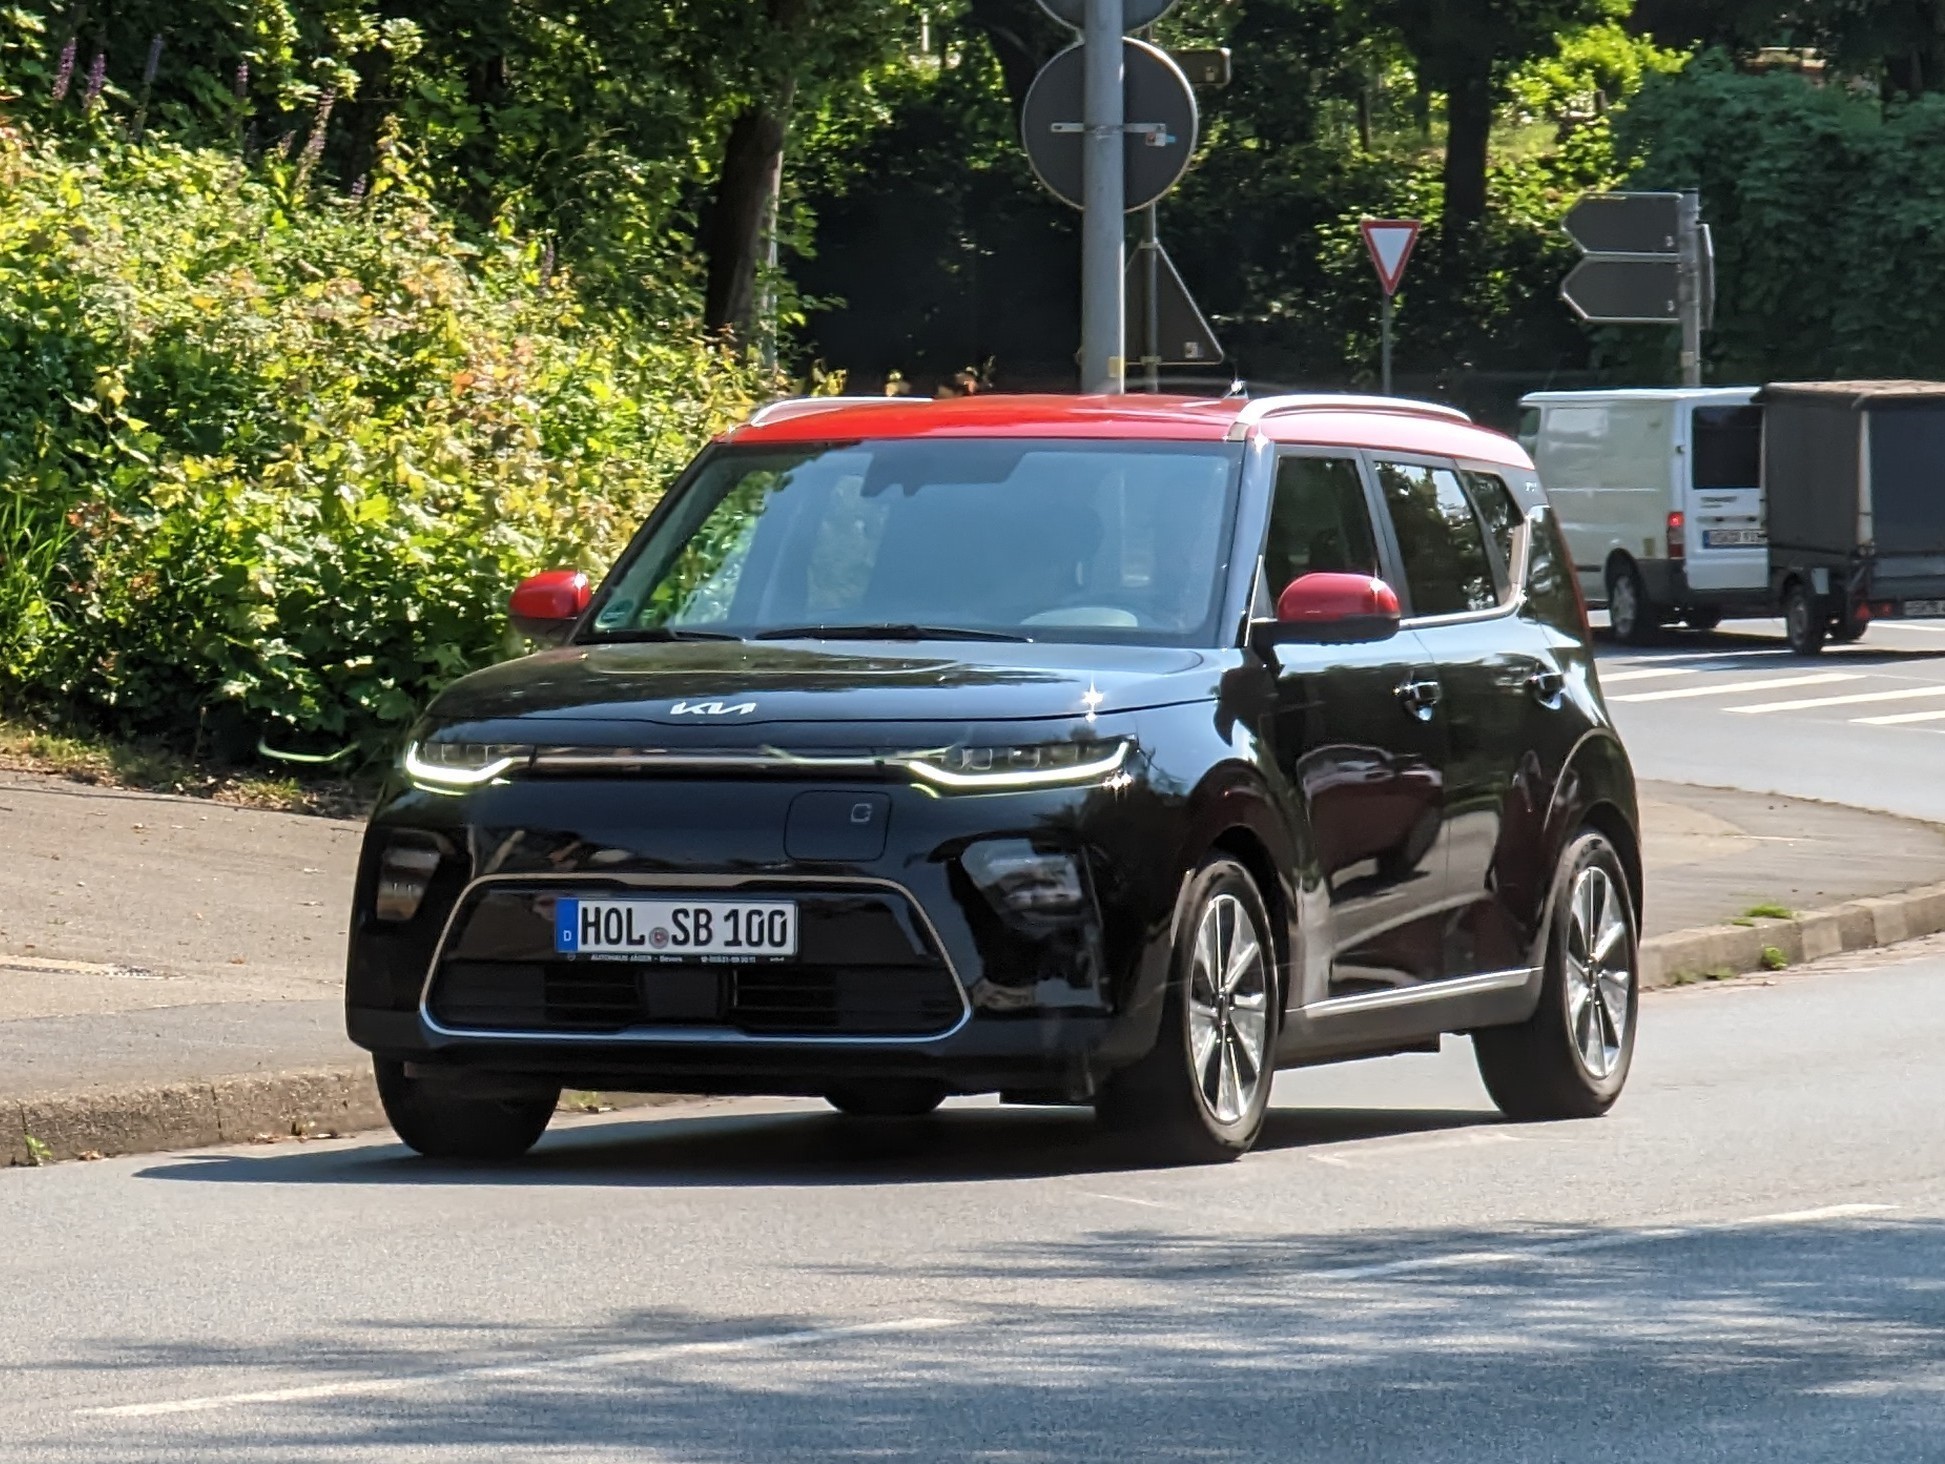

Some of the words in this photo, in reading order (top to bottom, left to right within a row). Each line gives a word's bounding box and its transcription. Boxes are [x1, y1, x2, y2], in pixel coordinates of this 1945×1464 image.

[669, 701, 757, 715] KIA
[581, 906, 645, 946] HOL
[671, 908, 713, 947] SB
[723, 908, 788, 947] 100
[563, 930, 572, 942] D
